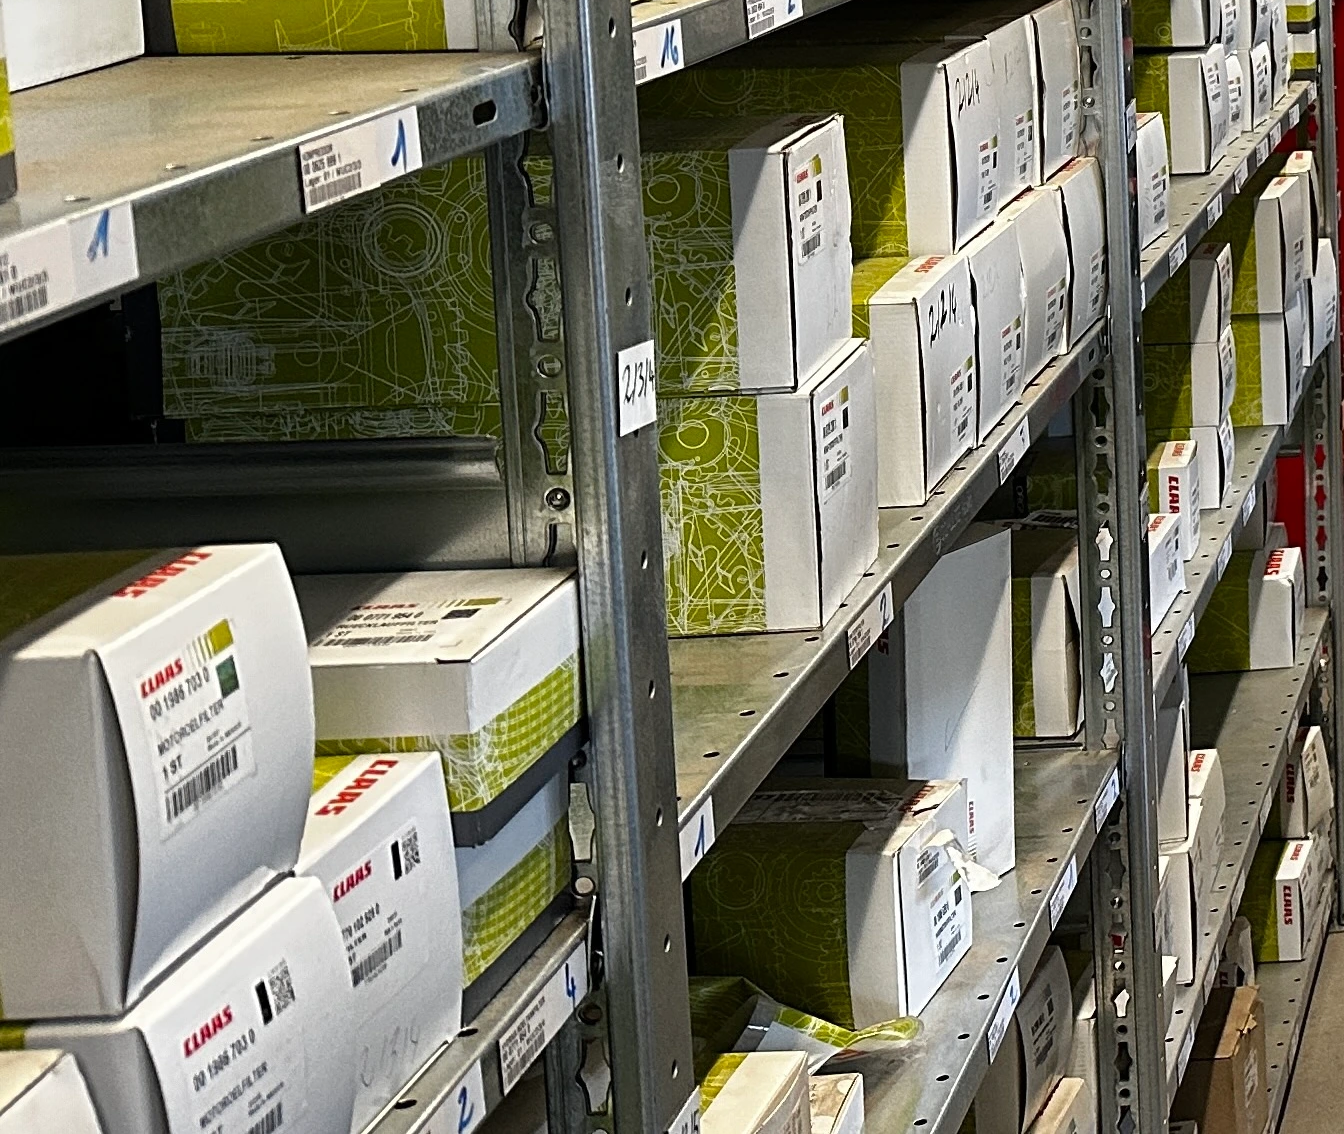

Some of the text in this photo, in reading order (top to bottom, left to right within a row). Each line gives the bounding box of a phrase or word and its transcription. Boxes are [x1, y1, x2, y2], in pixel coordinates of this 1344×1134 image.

[660, 25, 679, 68] 16
[1168, 475, 1180, 514] CLAA
[111, 551, 213, 599] CLAAS
[140, 658, 184, 700] CLAAS
[170, 754, 184, 775] ST
[314, 759, 399, 816] CLAAS
[333, 859, 373, 903] CLAAS
[1282, 885, 1292, 926] CLAAS
[565, 962, 577, 1007] 4
[183, 1004, 234, 1058] CLAAS
